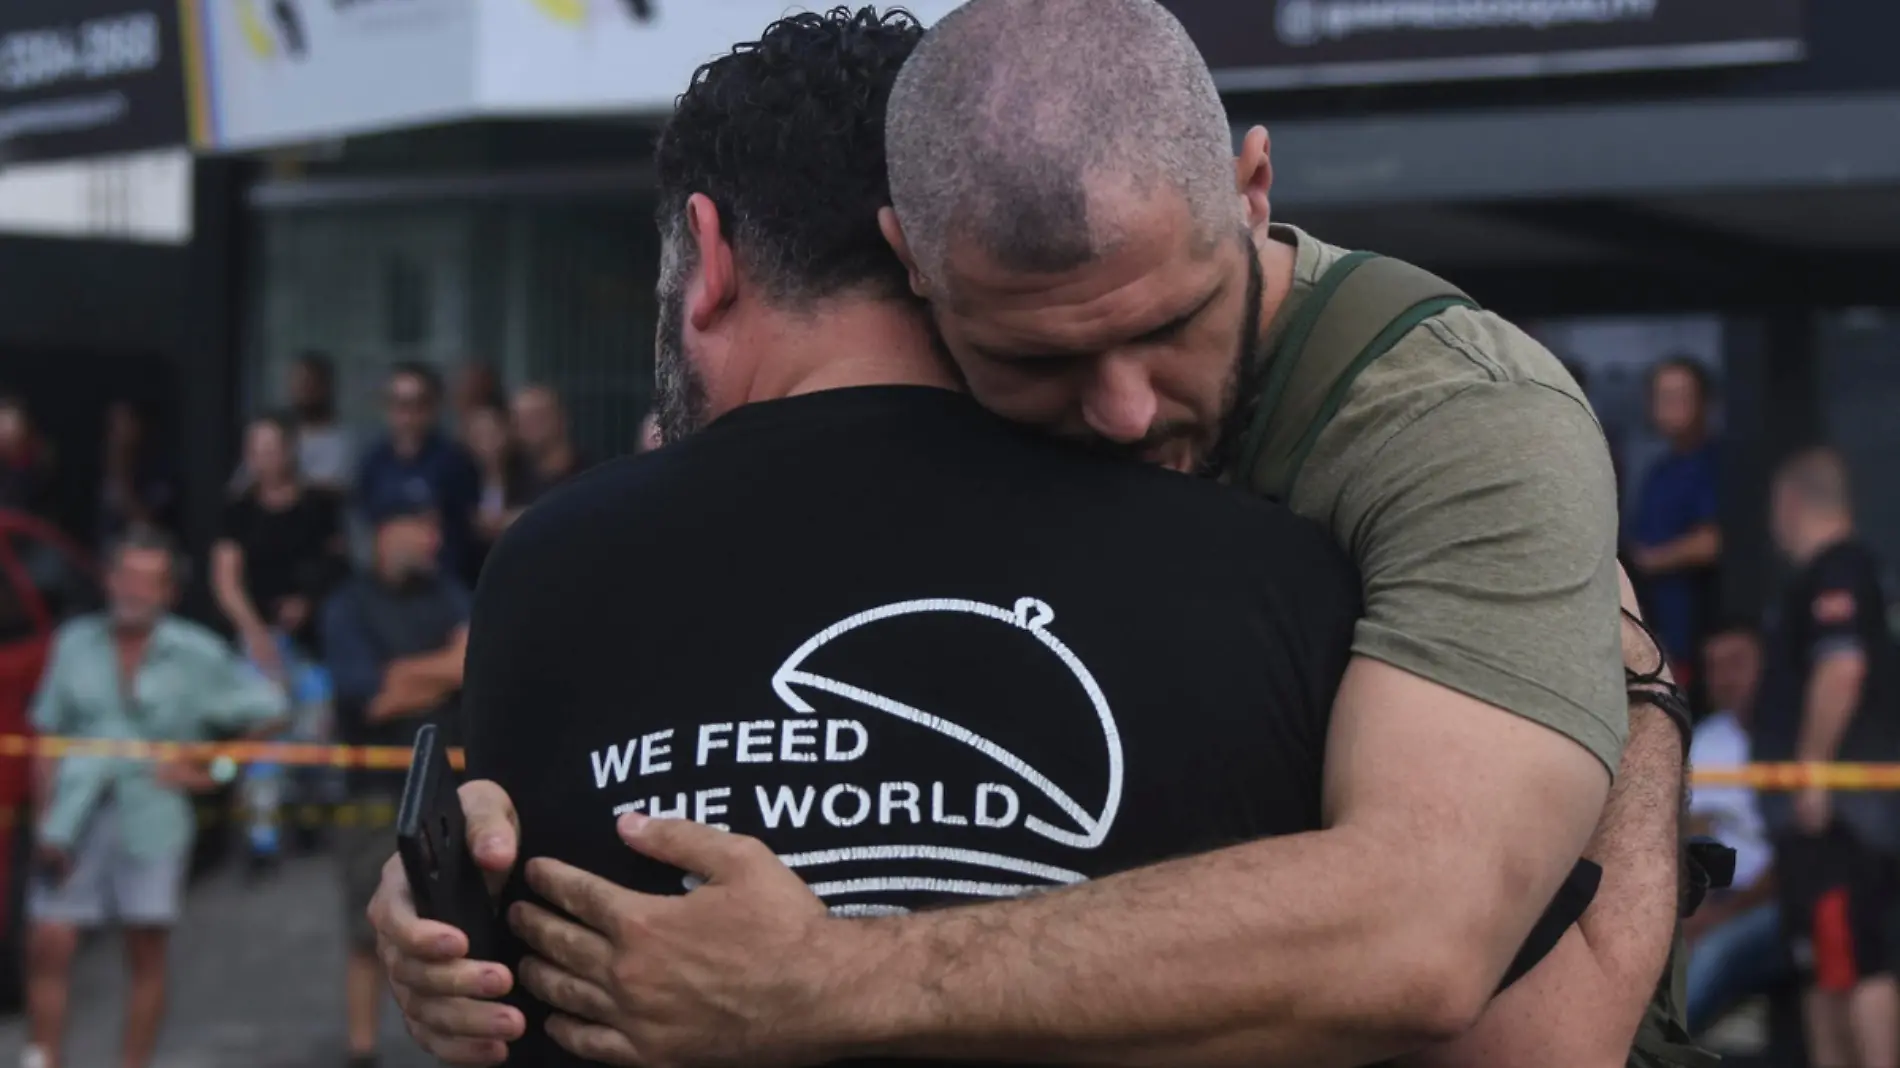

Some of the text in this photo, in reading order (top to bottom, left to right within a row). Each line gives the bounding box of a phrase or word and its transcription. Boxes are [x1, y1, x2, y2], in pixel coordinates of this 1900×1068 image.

[590, 718, 868, 788] WE FEED
[754, 780, 1019, 829] WORLD
